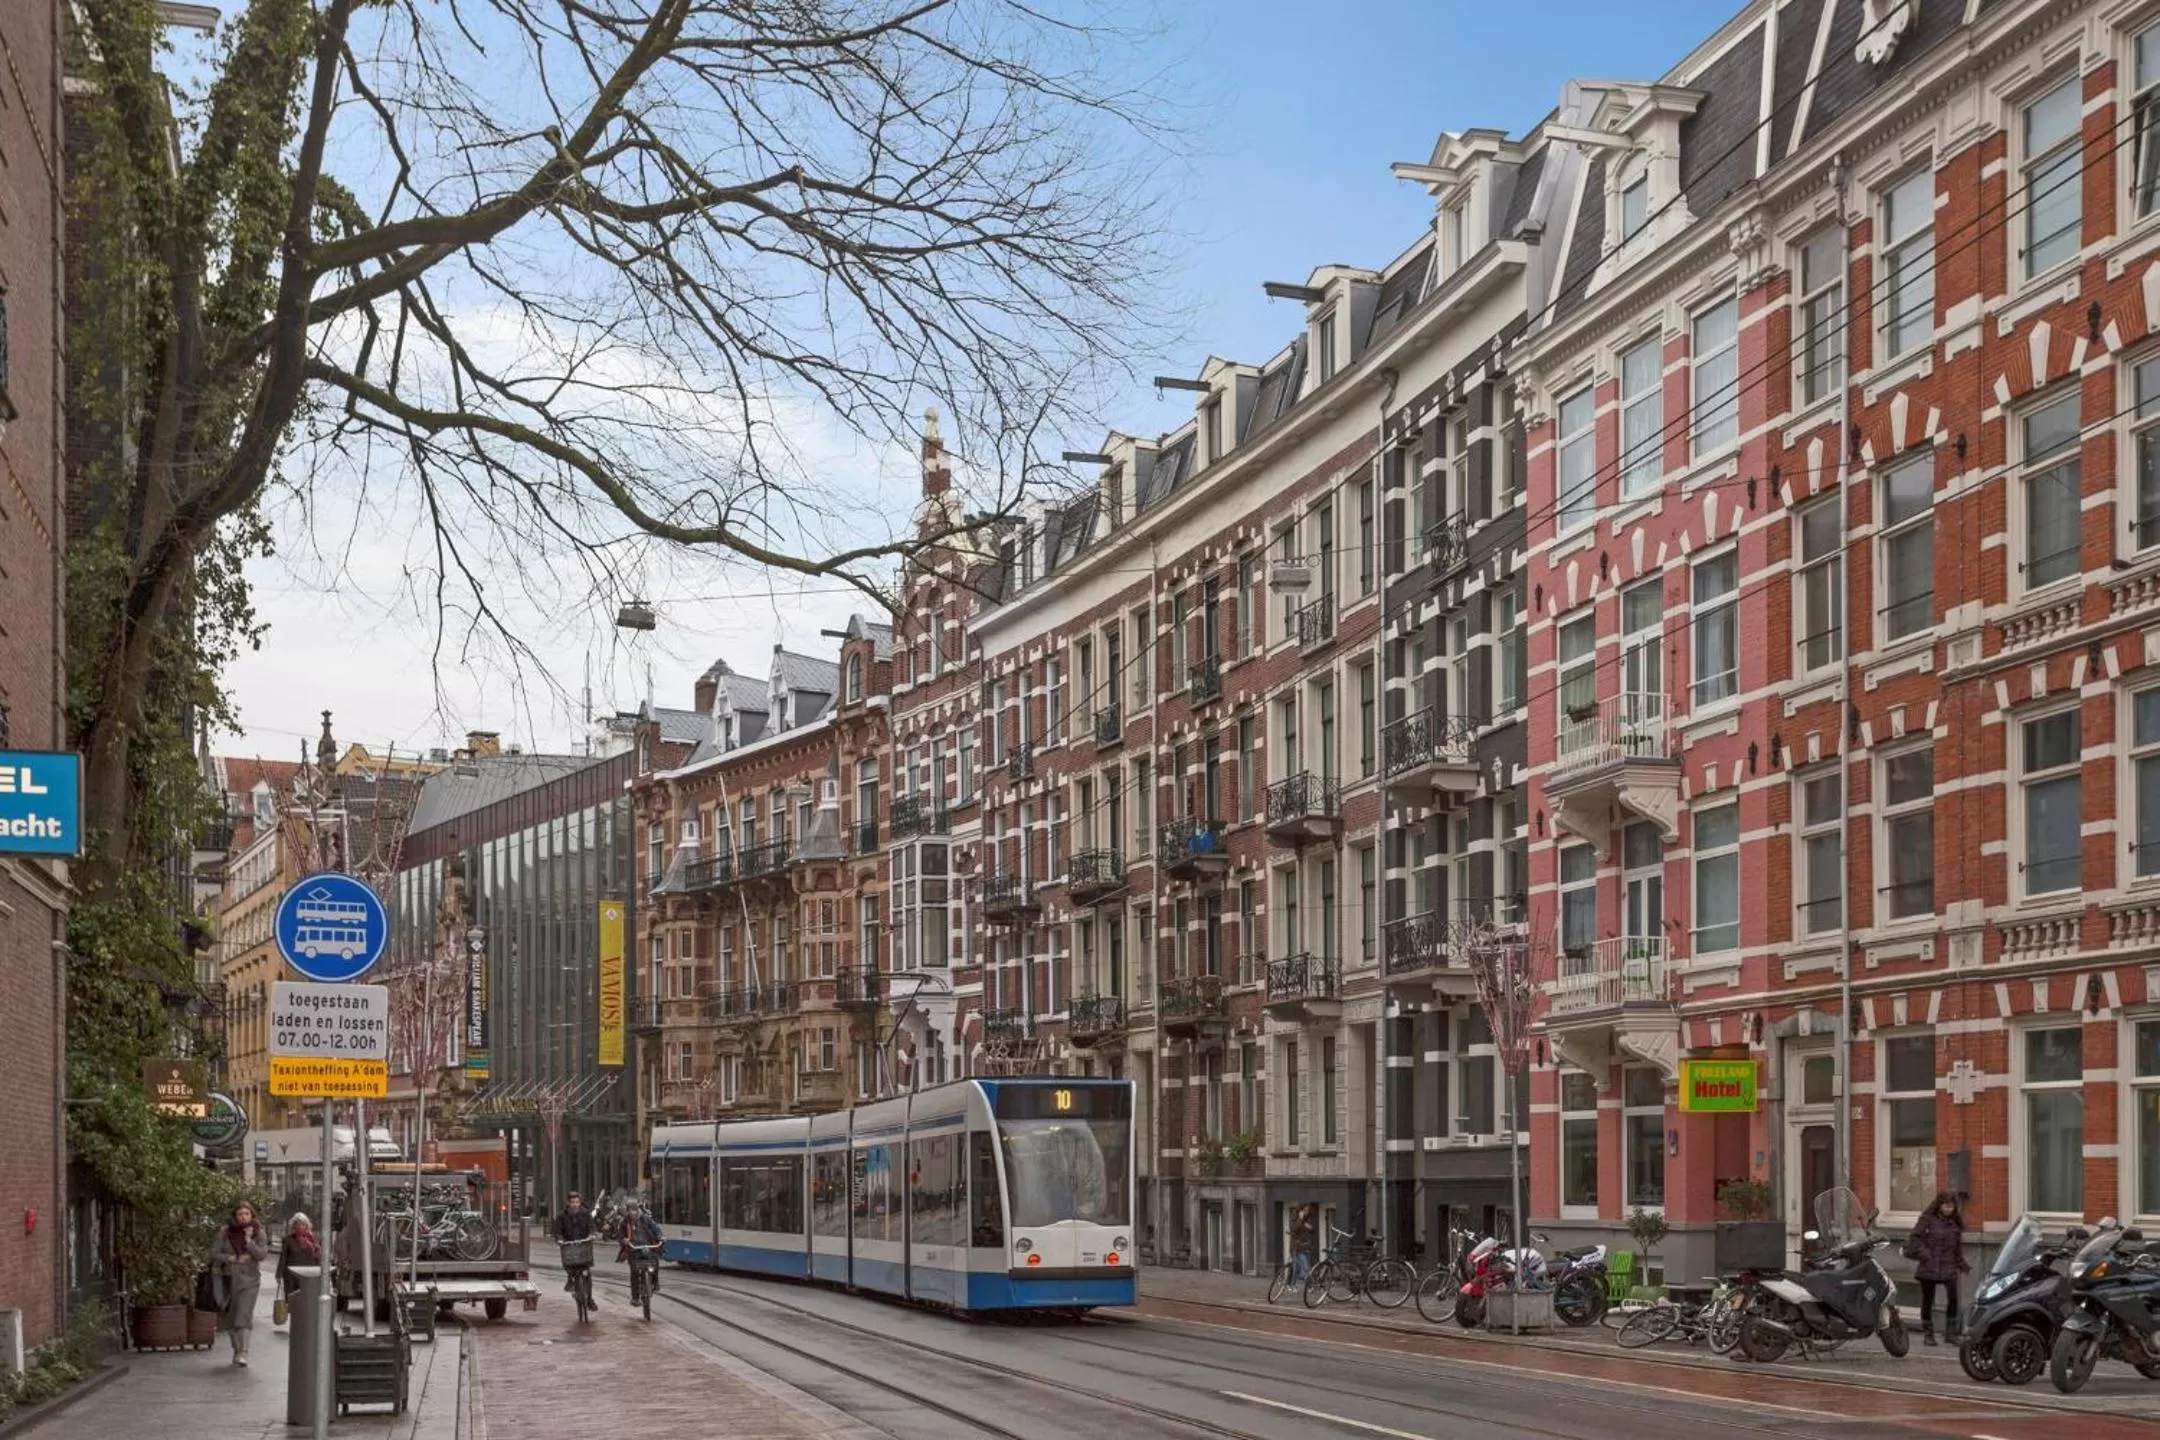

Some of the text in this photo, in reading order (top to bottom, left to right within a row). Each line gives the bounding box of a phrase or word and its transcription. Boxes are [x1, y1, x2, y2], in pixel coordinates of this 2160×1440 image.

[289, 991, 369, 1011] toegestaan
[272, 1011, 384, 1031] laden en lossen
[277, 1031, 377, 1050] 07.00-12.00h
[273, 1063, 349, 1078] Taxiontheffing
[277, 1081, 379, 1094] niet van toepassing
[1695, 1080, 1741, 1098] Hotel
[1054, 1089, 1071, 1110] 10
